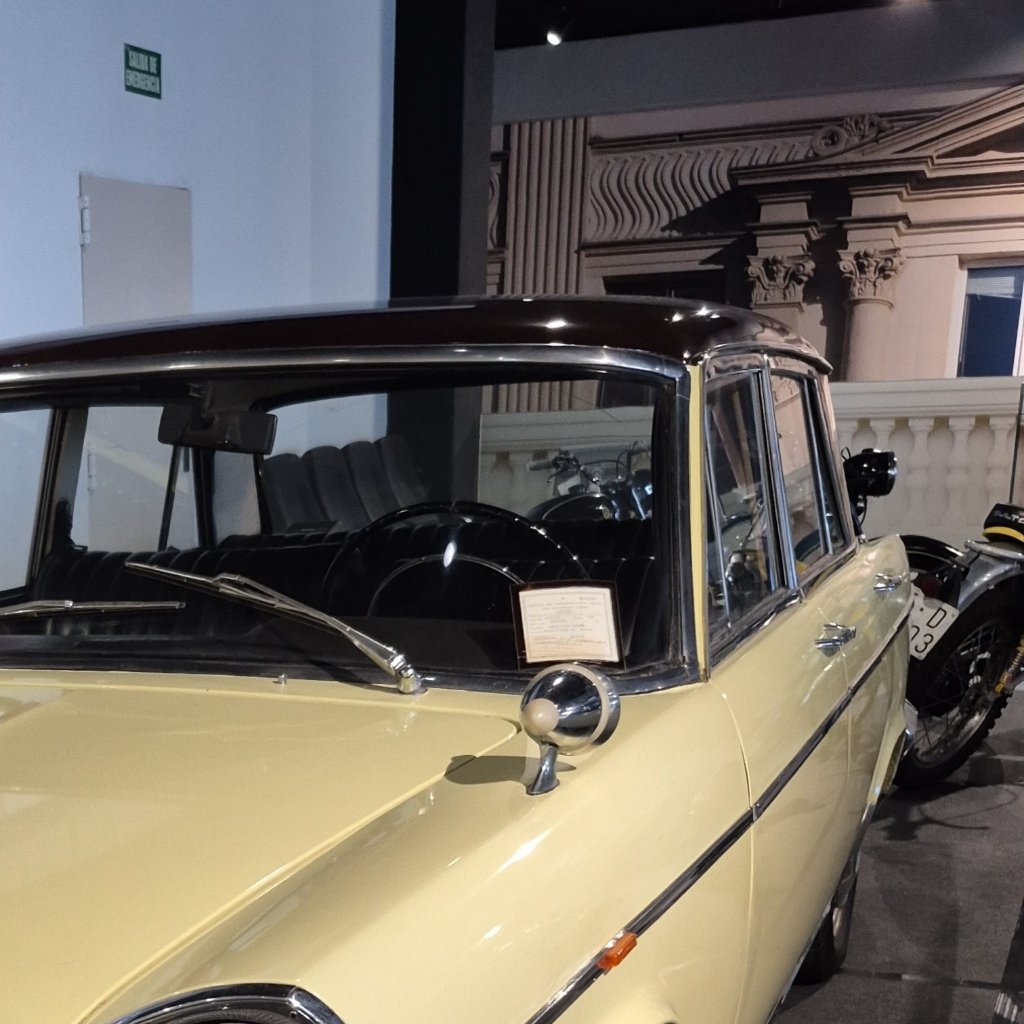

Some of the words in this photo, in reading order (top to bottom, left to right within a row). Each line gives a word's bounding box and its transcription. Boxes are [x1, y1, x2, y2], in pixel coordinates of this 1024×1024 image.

[129, 50, 148, 71] SALIDA
[149, 56, 158, 74] DE
[126, 69, 160, 94] EMERGENCIA
[926, 606, 947, 629] D
